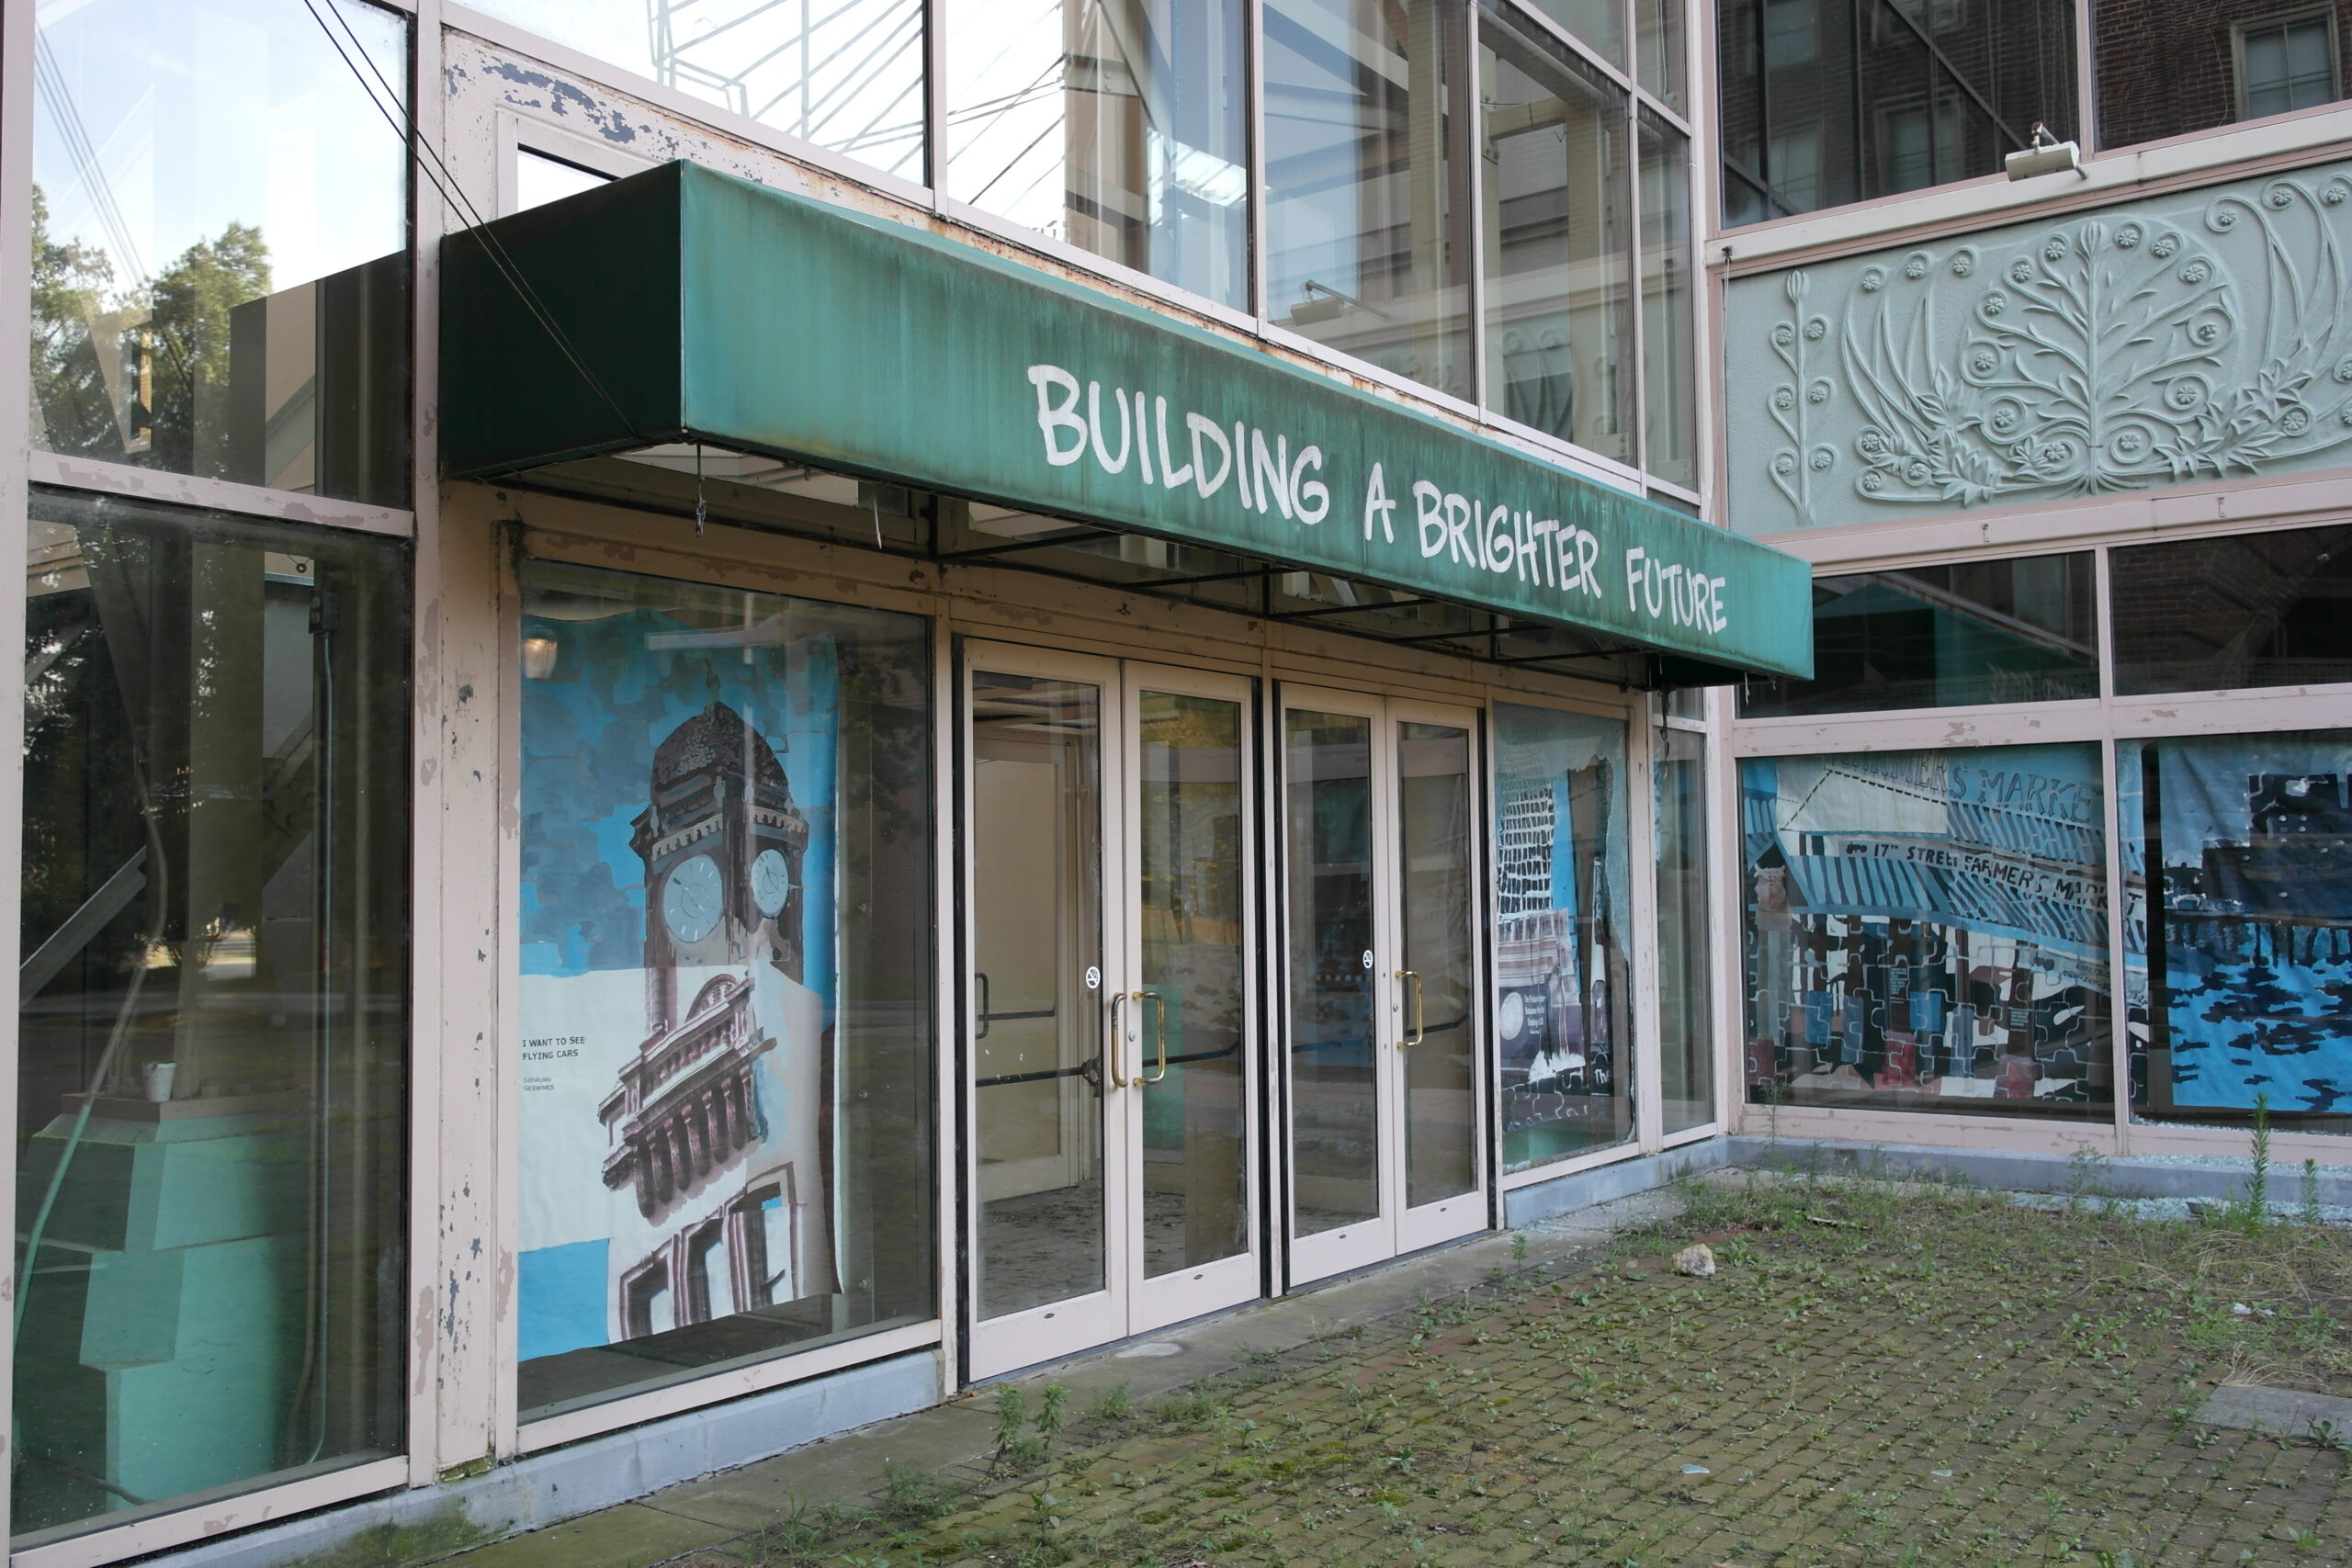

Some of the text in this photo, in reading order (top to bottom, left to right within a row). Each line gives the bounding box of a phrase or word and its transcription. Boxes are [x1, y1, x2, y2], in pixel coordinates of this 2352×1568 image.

[1027, 364, 1727, 636] BUILDING A BRIGHTER FUTURE
[528, 1038, 553, 1047] WANT
[555, 1037, 567, 1045] TO
[569, 1036, 585, 1044] SEE
[522, 1049, 579, 1060] FLYING CARS
